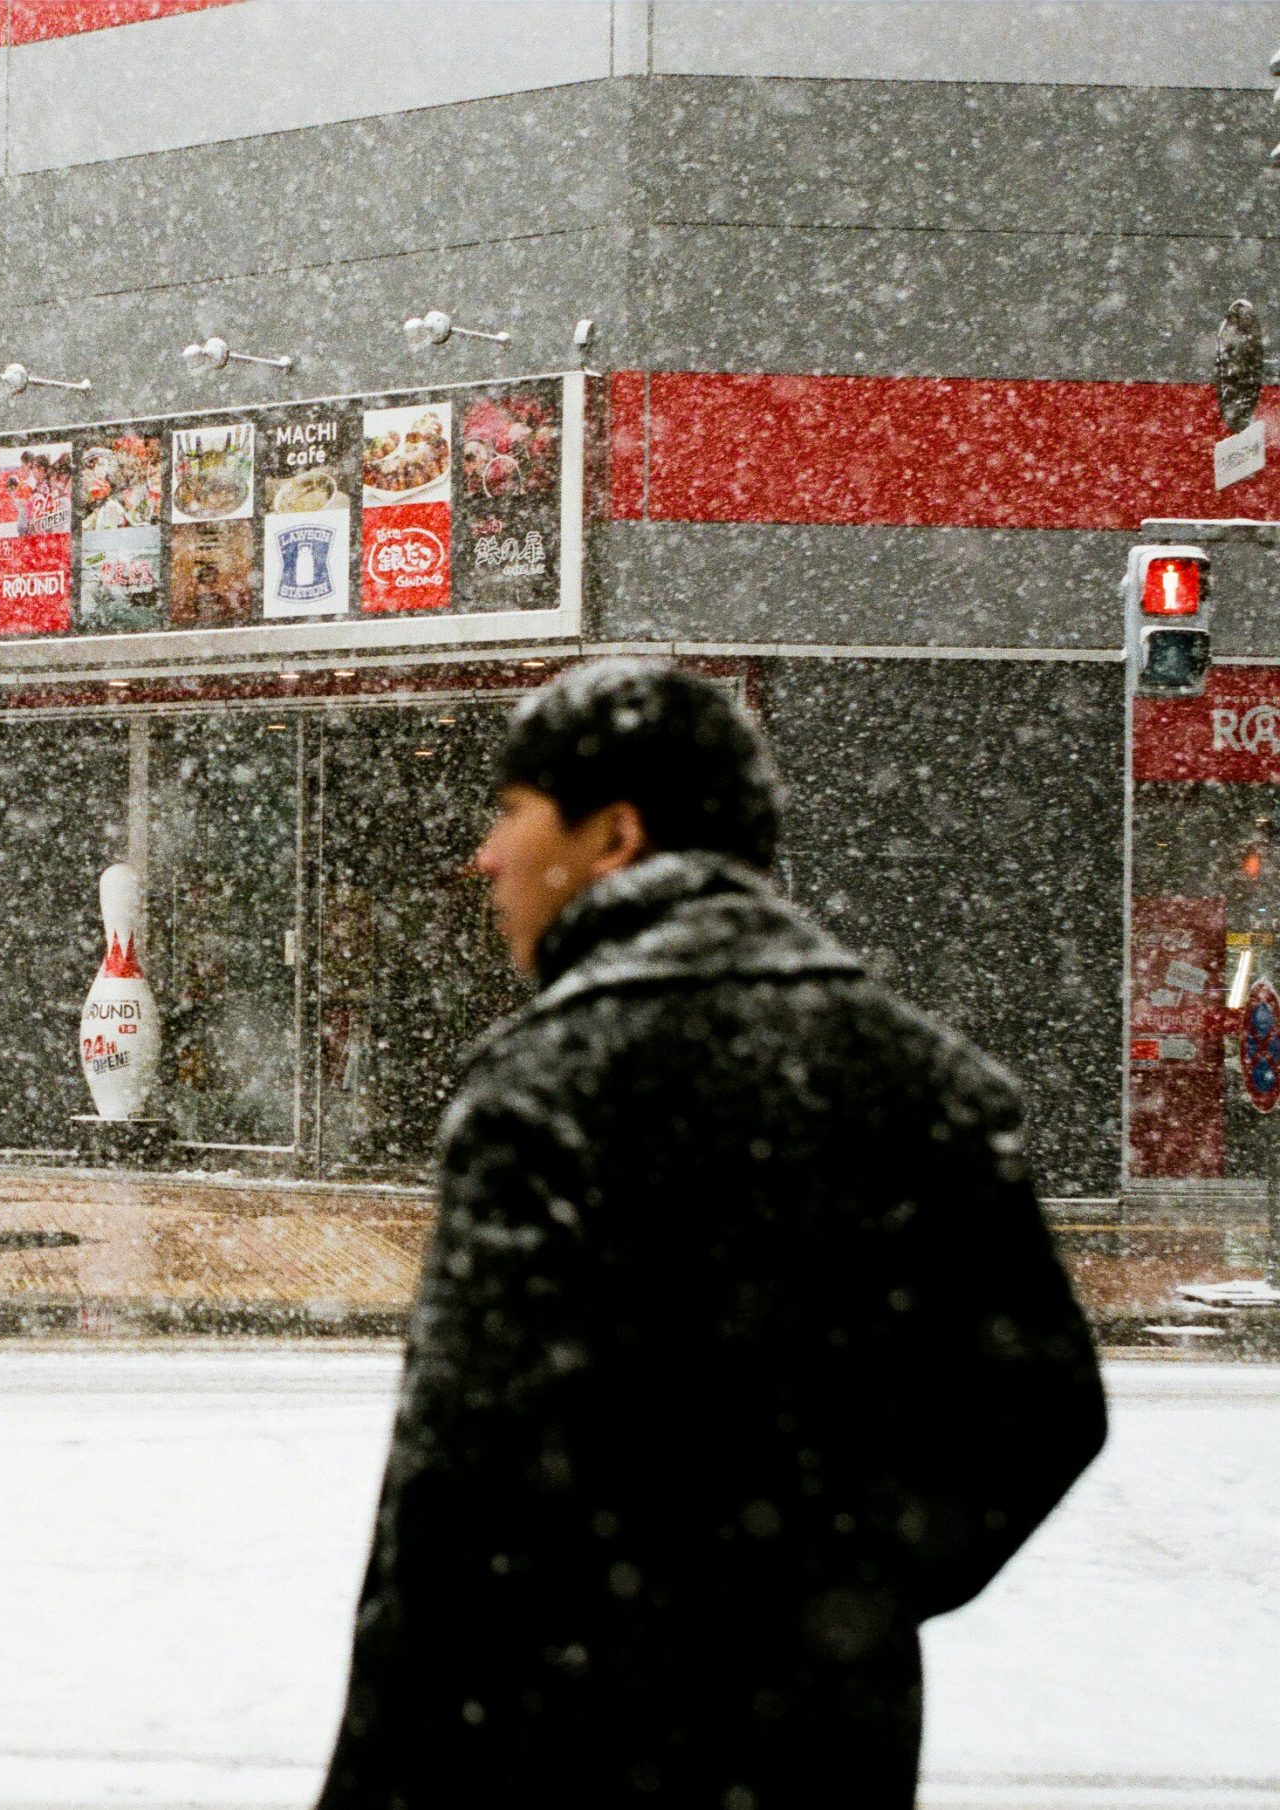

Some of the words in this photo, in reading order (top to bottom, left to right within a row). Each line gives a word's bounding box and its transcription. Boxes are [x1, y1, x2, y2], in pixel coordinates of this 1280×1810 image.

[277, 421, 337, 445] MACHI
[286, 445, 326, 466] café
[280, 530, 332, 546] LAWSON
[2, 570, 65, 599] ROUND1
[280, 583, 328, 599] STATION
